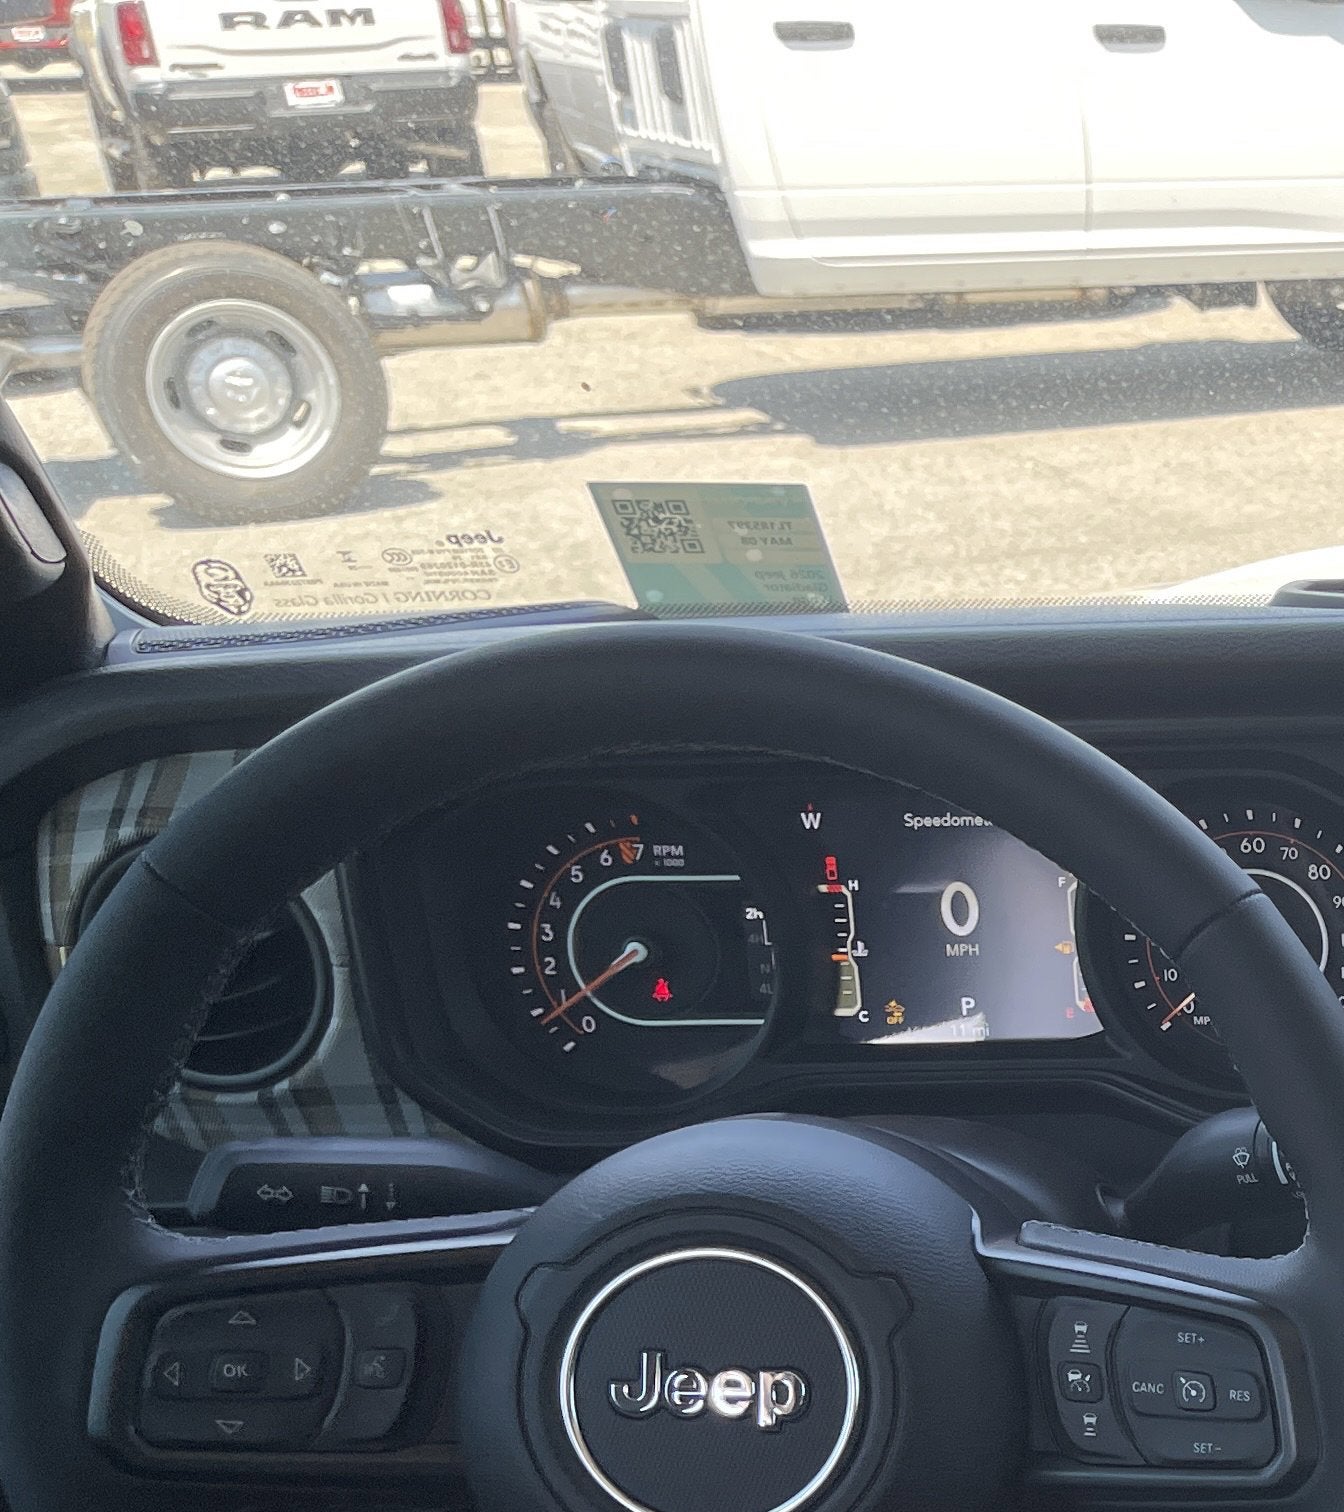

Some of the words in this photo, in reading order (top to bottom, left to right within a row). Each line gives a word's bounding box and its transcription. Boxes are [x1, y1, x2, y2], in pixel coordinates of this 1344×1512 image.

[219, 9, 375, 31] RAM
[801, 812, 821, 830] W
[904, 813, 993, 829] Speedome
[632, 844, 644, 860] 7
[653, 845, 684, 856] RPM
[1241, 837, 1265, 853] 60
[600, 850, 612, 866] 6
[1280, 847, 1298, 860] 70
[570, 866, 583, 883] 5
[1308, 864, 1330, 880] 80
[848, 880, 859, 891] H
[1058, 877, 1066, 887] F
[550, 893, 561, 907] 4
[941, 881, 980, 936] 0
[541, 925, 553, 941] 3
[946, 944, 979, 956] MPH
[545, 958, 556, 974] 2
[1164, 968, 1178, 981] 10
[961, 997, 975, 1016] P
[582, 1016, 595, 1032] 0
[859, 1012, 869, 1022] C
[1193, 1016, 1211, 1025] MP
[1236, 1173, 1258, 1184] PULL
[1177, 1331, 1205, 1344] SET+
[224, 1362, 248, 1378] OK
[609, 1350, 810, 1432] Jeep
[1132, 1382, 1164, 1394] CANC
[1229, 1389, 1250, 1402] RES
